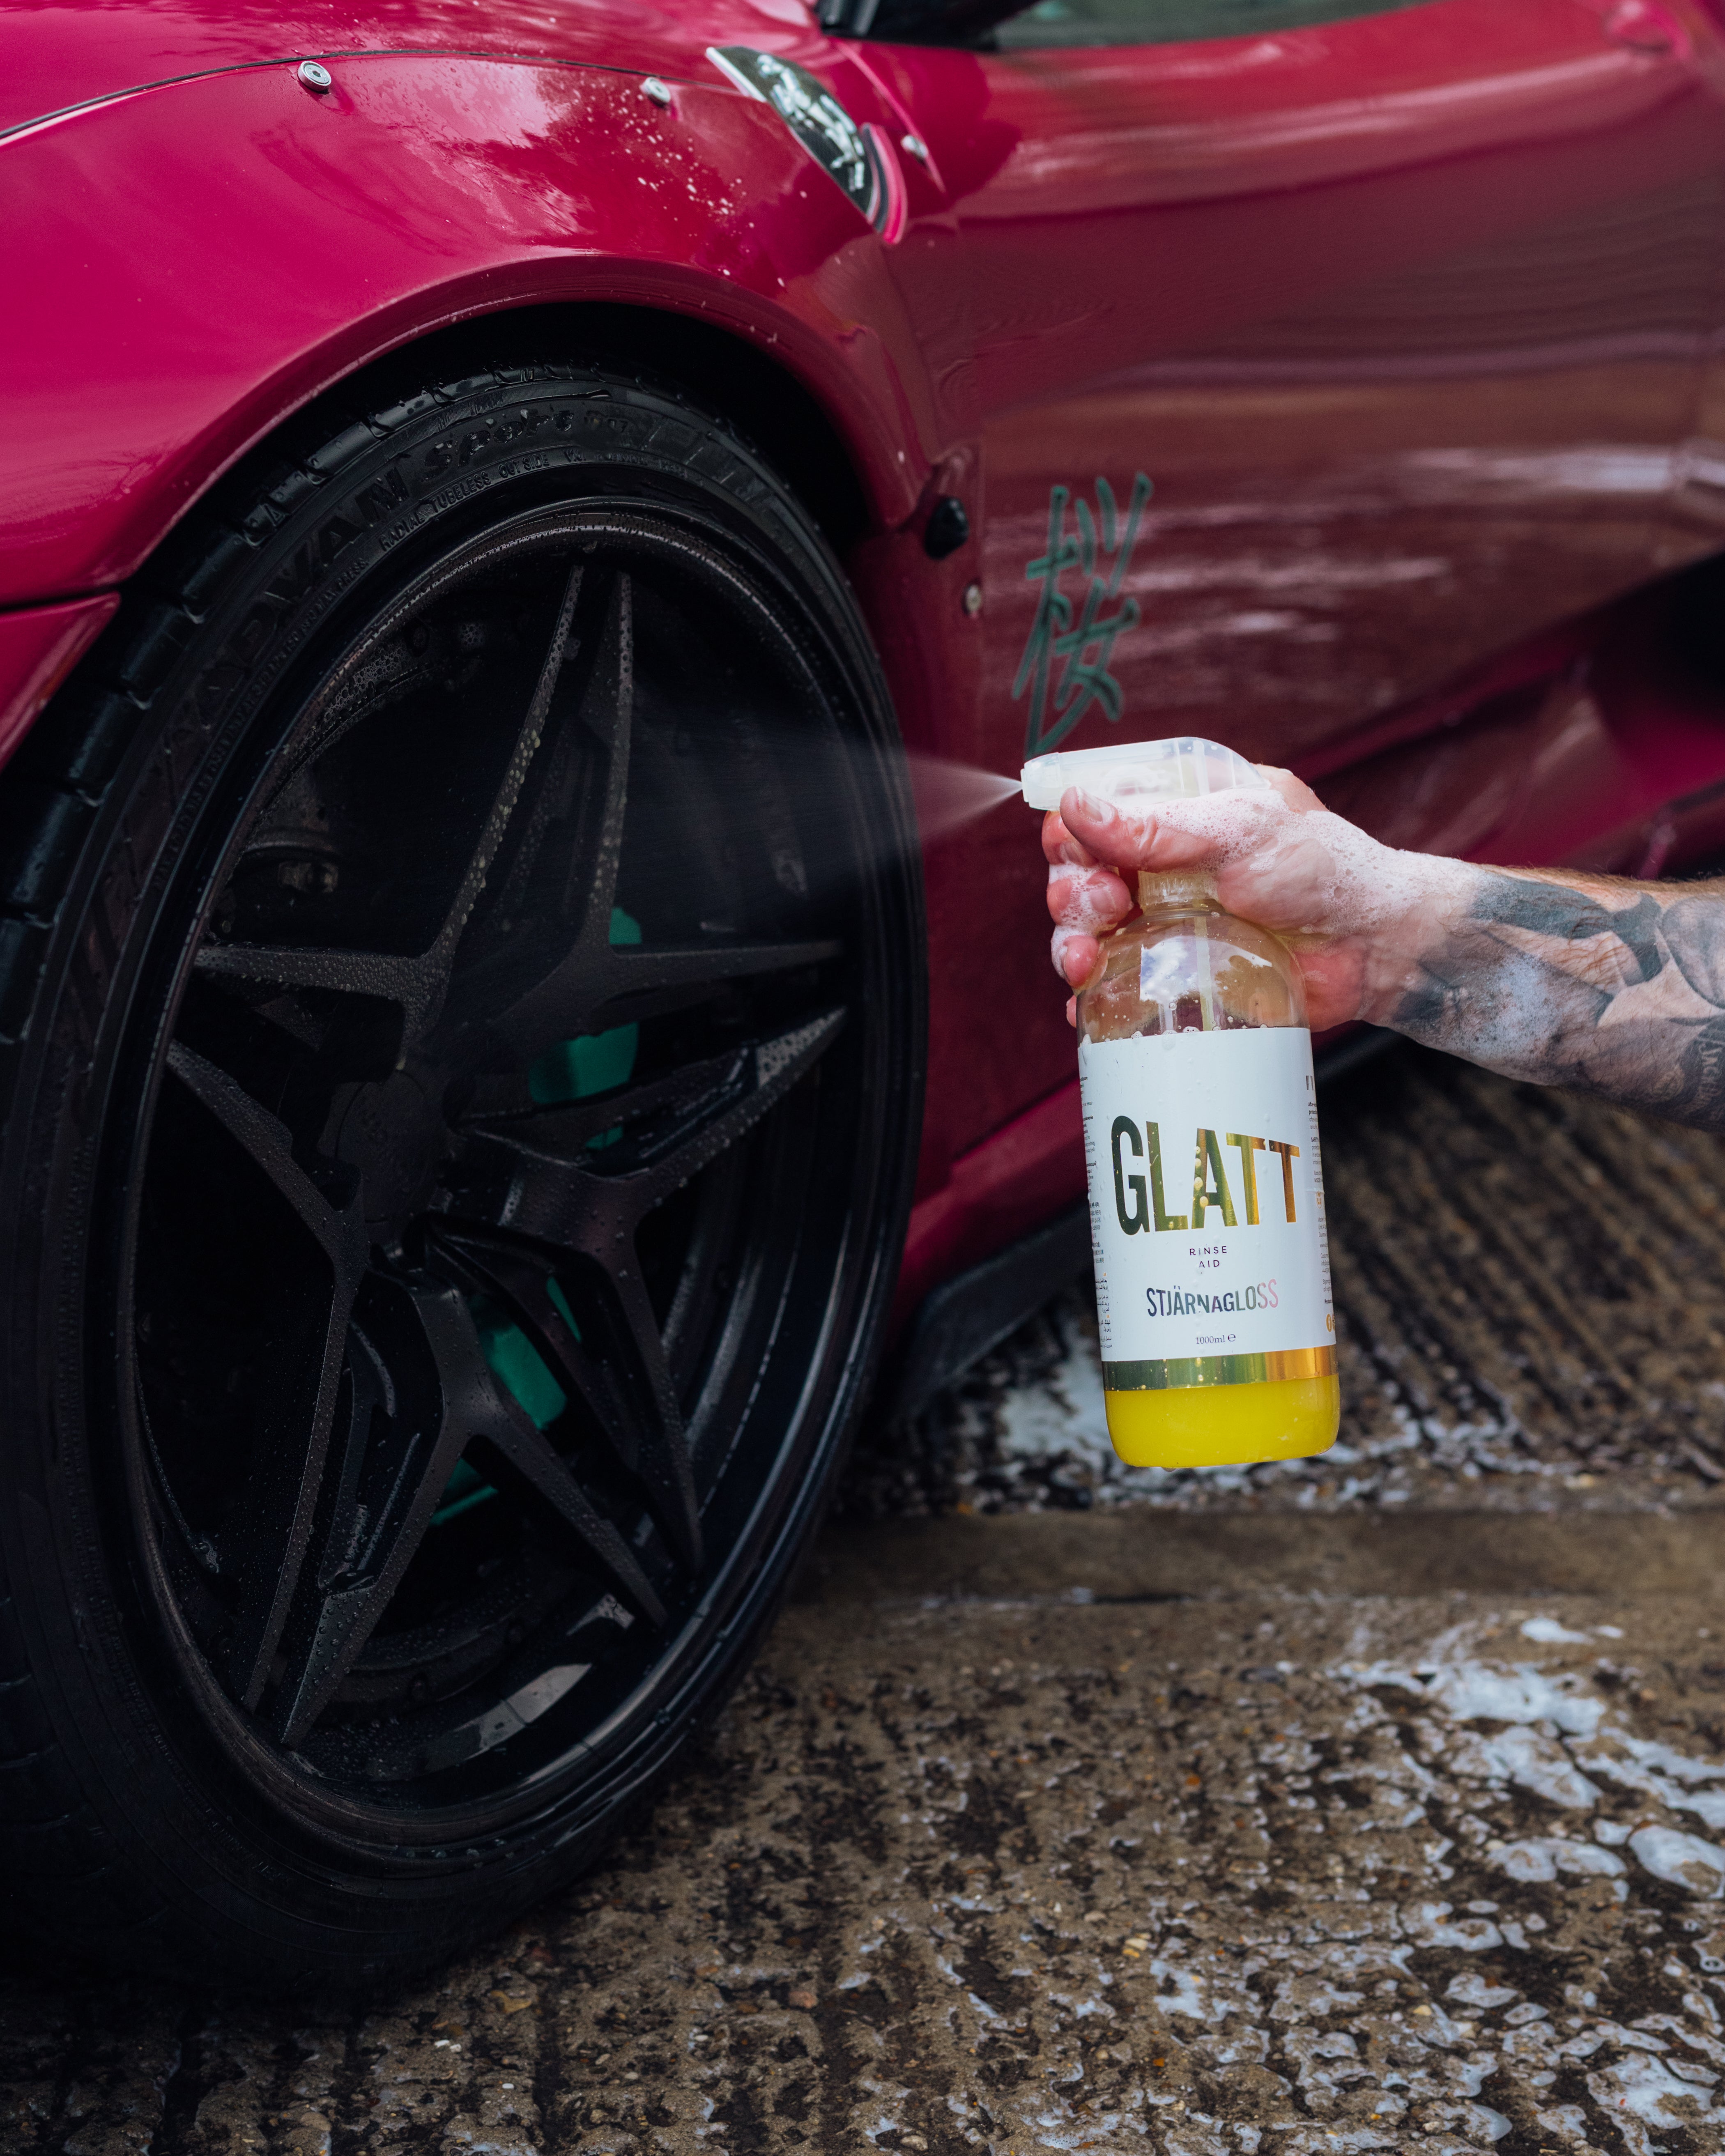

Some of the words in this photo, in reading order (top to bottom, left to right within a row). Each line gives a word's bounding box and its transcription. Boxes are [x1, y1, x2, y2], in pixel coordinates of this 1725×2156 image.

[378, 509, 424, 552] RADIAL
[429, 471, 491, 513] TUBELESS
[194, 467, 410, 729] ADVAN
[1111, 1115, 1300, 1235] GLATT
[1189, 1246, 1227, 1255] RINSE
[1147, 1278, 1278, 1317] STJÄRNAGLOSS
[1195, 1335, 1226, 1344] 1000ml
